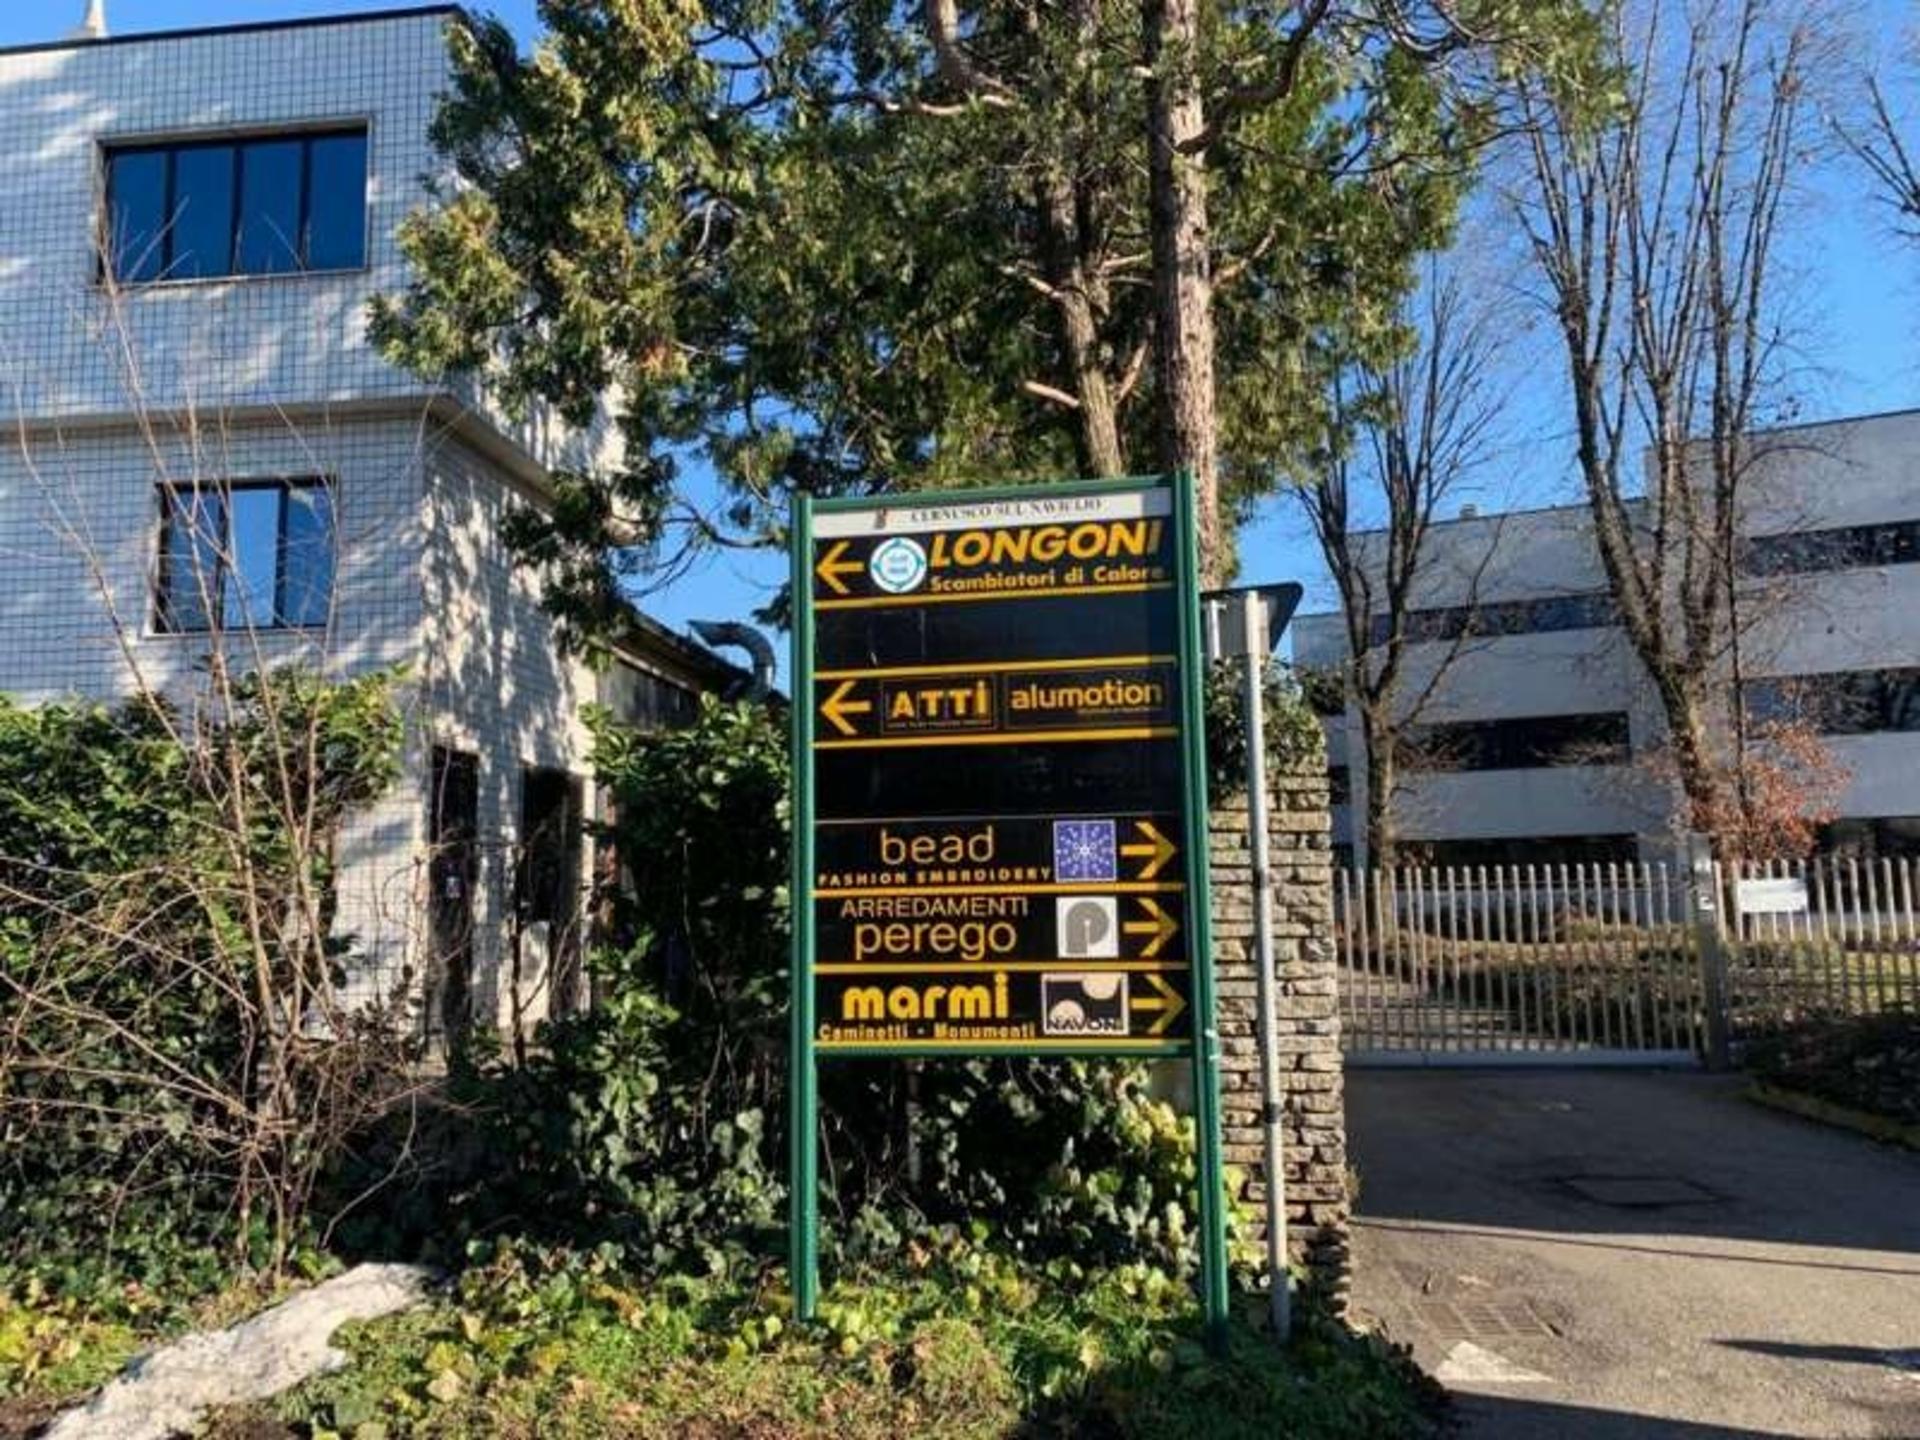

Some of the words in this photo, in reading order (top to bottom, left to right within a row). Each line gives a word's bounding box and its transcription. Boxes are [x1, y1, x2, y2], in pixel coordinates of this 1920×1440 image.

[929, 521, 1163, 567] LONGONI
[930, 569, 1056, 592] Scambiatori
[1065, 565, 1084, 584] di
[1093, 563, 1164, 583] Calore
[1010, 679, 1163, 710] alumotion
[880, 825, 995, 865] bead
[818, 871, 907, 886] FASHION
[916, 866, 1051, 884] EMBROIDERY
[840, 896, 1029, 918] ARREDAMENTI
[855, 921, 1018, 961] perego
[842, 971, 1010, 1019] marmi
[818, 1022, 909, 1040] Caminetti
[933, 1021, 1036, 1039] Monumenti
